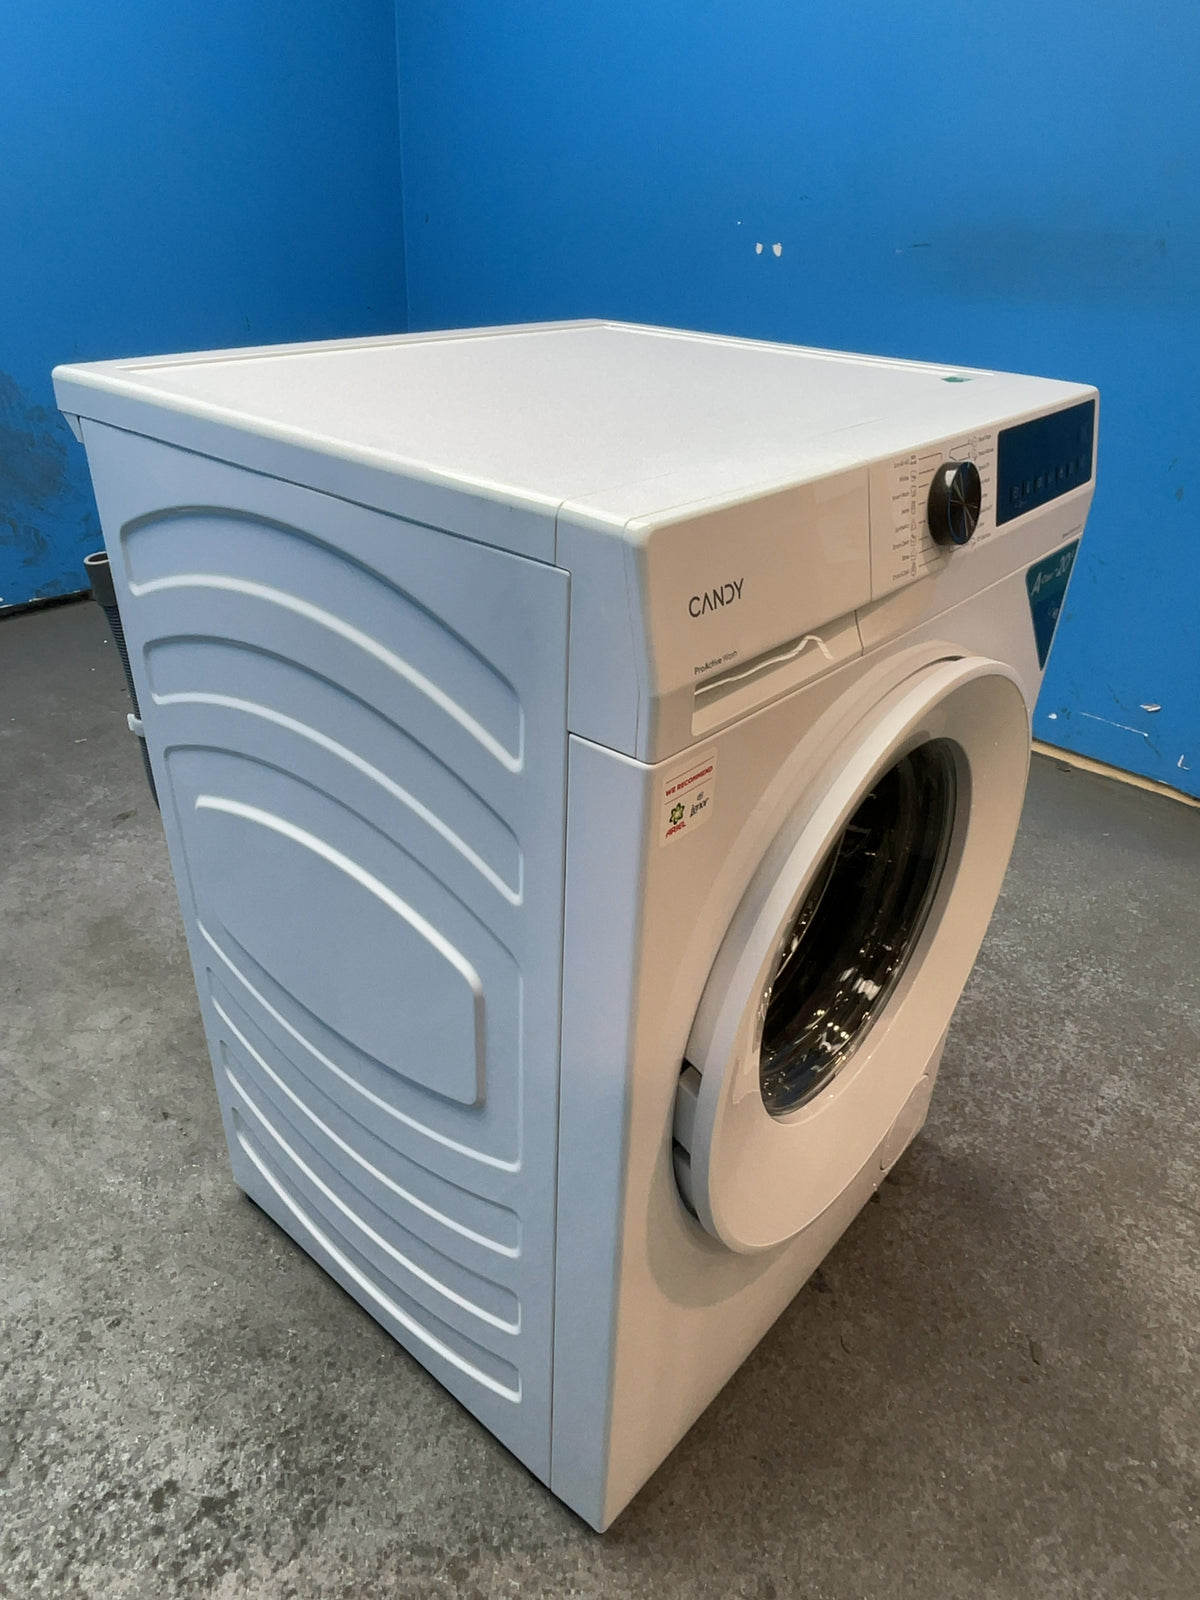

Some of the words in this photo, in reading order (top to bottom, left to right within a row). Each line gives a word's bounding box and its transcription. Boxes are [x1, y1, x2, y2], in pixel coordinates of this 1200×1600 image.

[688, 577, 744, 618] CANDY
[694, 657, 722, 675] ProActive
[665, 785, 676, 797] WE
[676, 765, 714, 792] RECOMMEND
[665, 820, 687, 838] ARIEL
